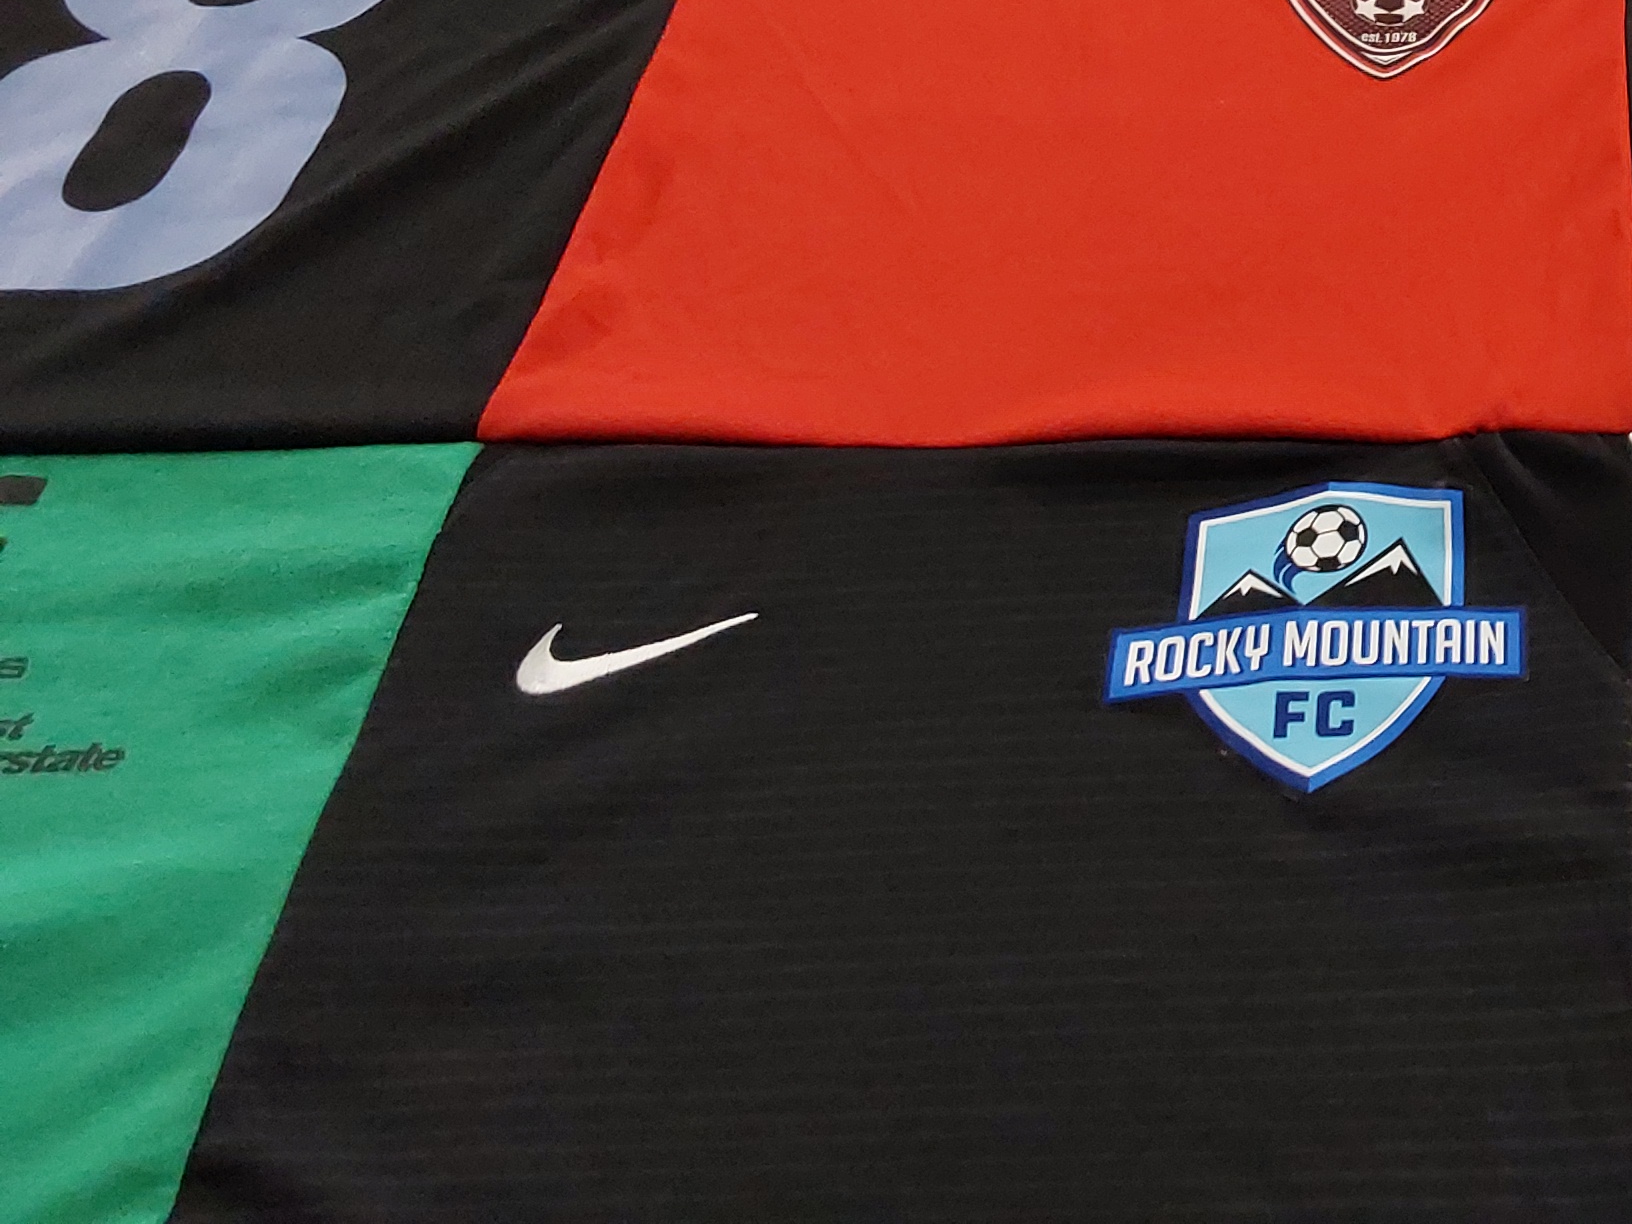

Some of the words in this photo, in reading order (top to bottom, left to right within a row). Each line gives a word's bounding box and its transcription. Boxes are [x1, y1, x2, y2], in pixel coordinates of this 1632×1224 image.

[1122, 622, 1270, 688] ROCKY
[1282, 617, 1506, 668] MOUNTAIN
[1272, 688, 1357, 740] FC
